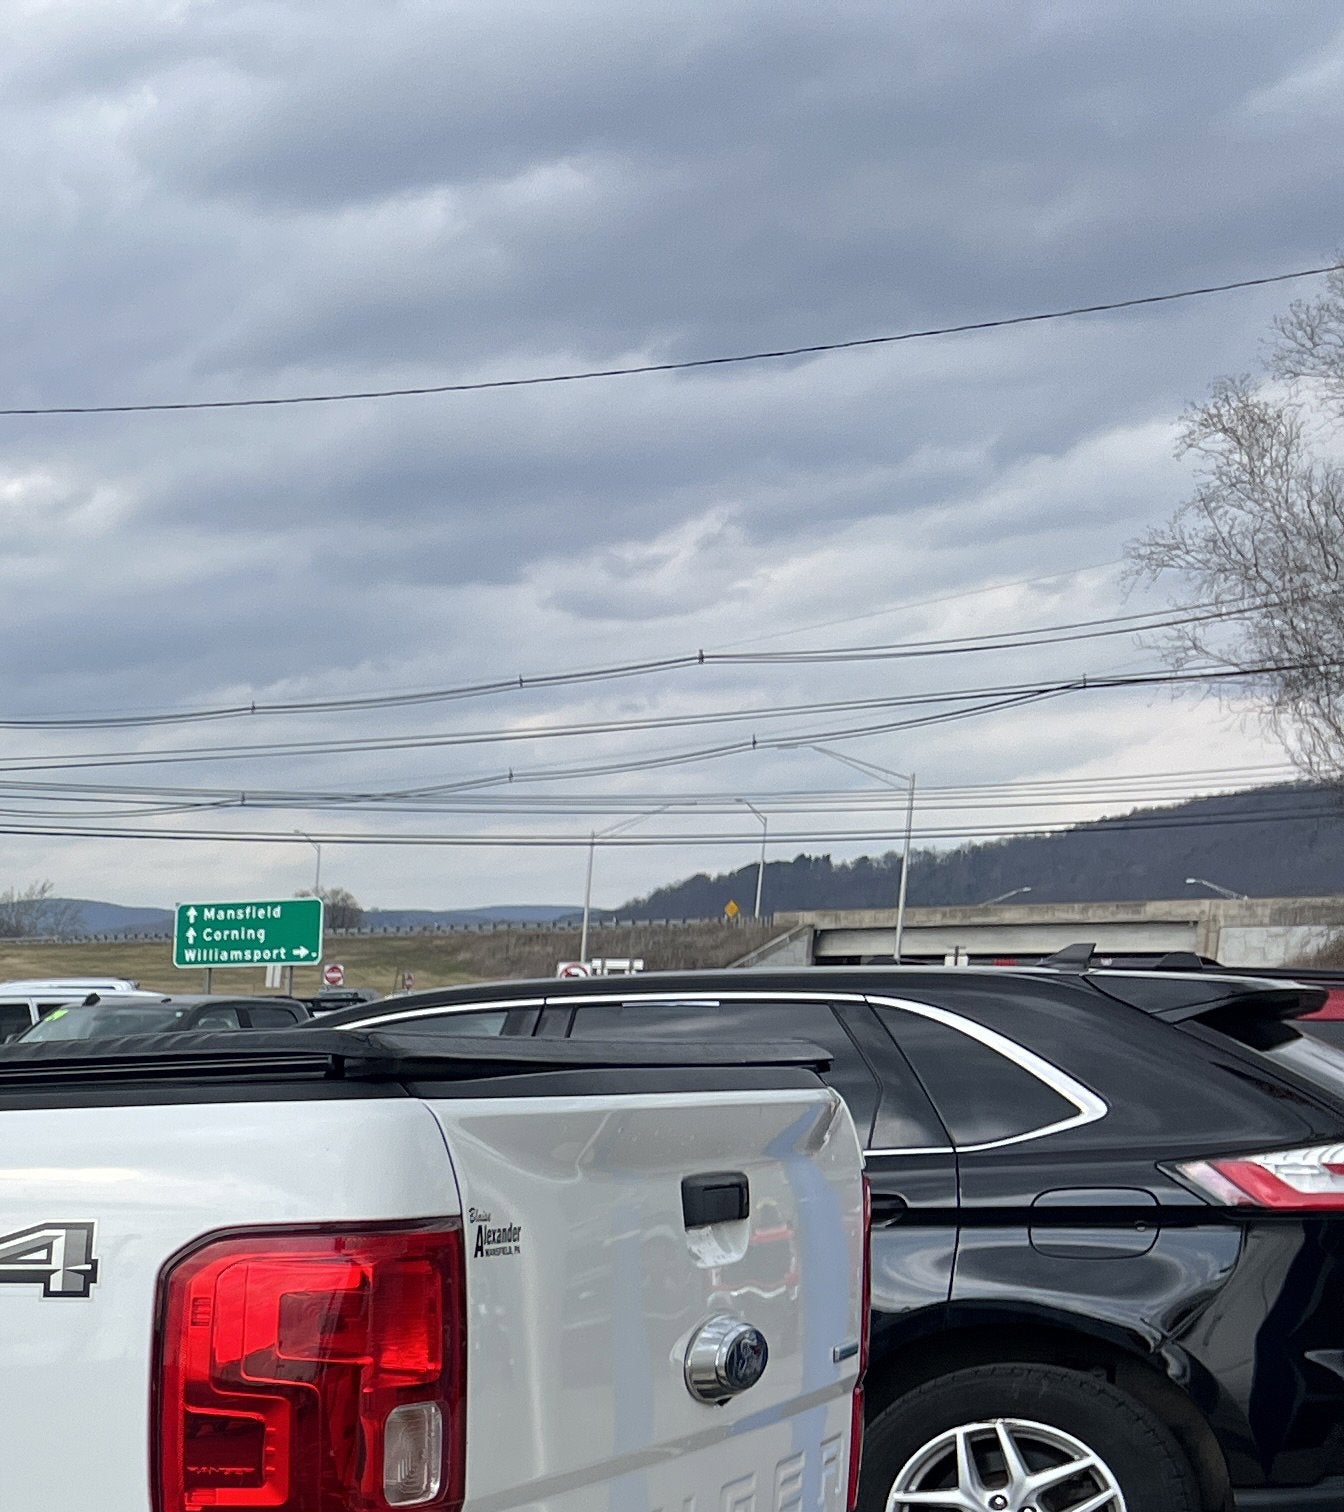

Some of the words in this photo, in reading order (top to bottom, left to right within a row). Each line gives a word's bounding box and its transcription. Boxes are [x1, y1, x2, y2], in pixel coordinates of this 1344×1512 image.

[203, 905, 282, 921] Mansfield
[202, 926, 266, 943] Corning
[183, 946, 287, 962] Williamsport
[474, 1222, 521, 1258] Alexander
